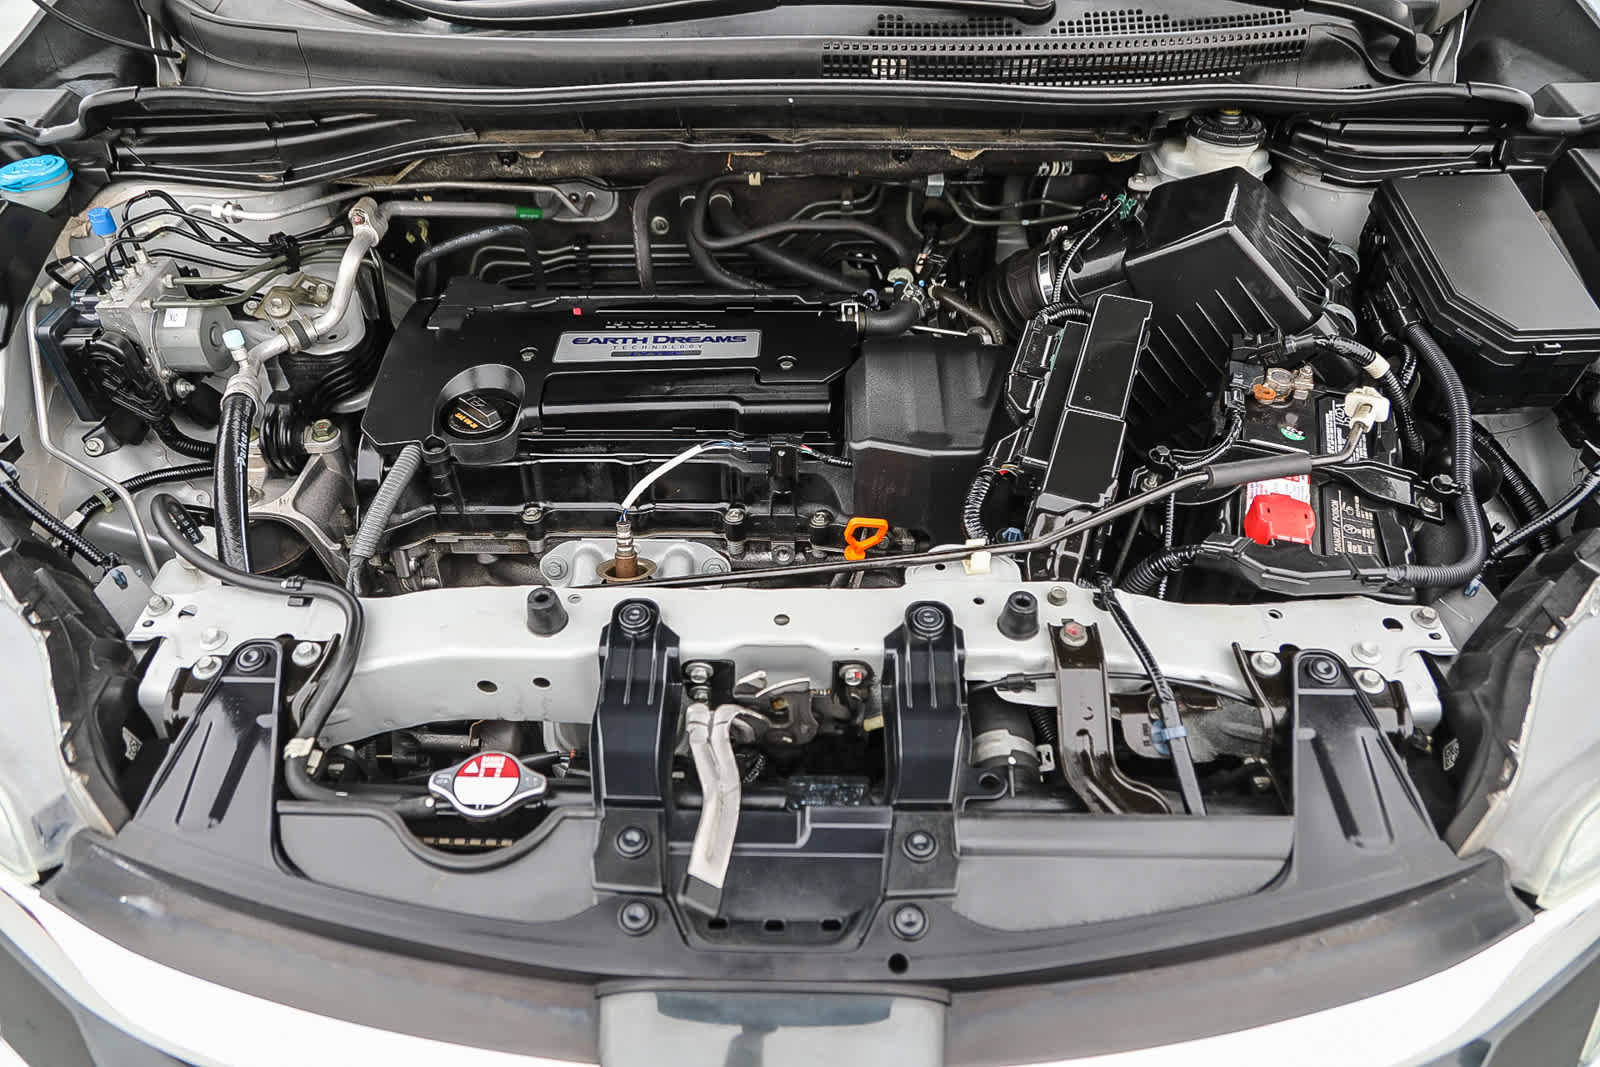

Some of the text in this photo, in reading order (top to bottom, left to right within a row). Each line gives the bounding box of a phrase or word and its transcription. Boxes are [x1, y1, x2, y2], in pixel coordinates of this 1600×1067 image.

[572, 335, 747, 345] EARTH DREAMS
[236, 432, 248, 468] Parker
[1330, 499, 1341, 522] POISON
[1332, 526, 1343, 553] DANGER
